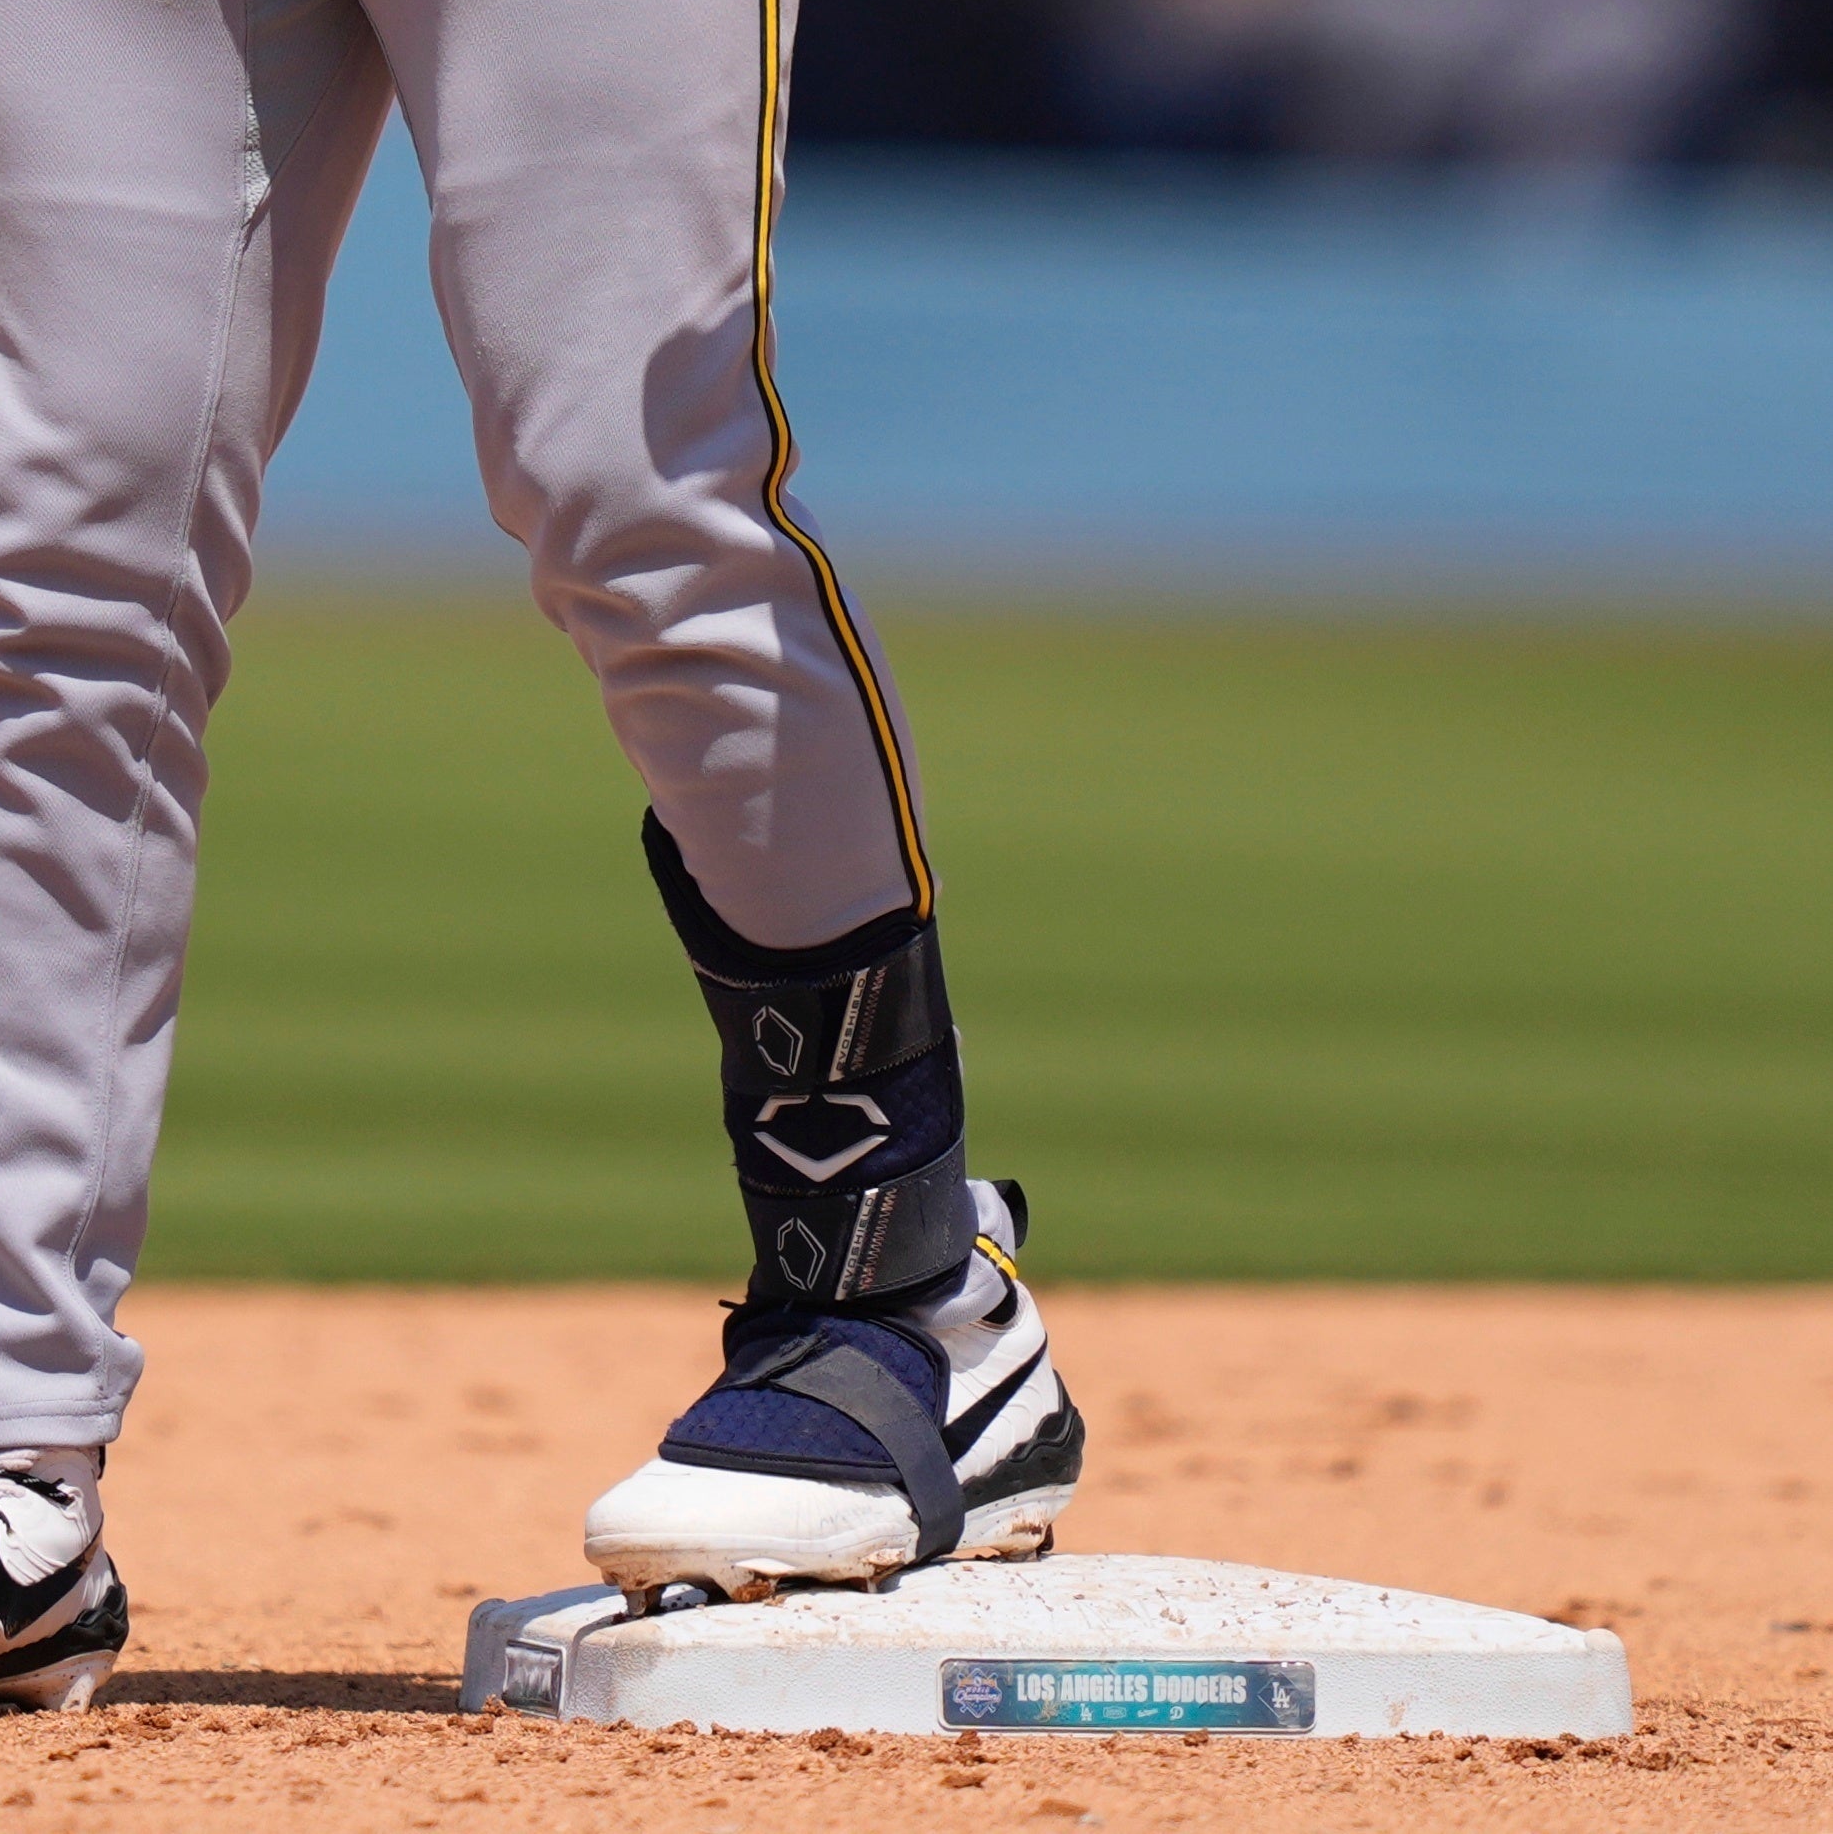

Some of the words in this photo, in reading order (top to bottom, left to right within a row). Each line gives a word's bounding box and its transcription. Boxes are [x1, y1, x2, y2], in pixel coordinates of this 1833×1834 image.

[835, 977, 867, 1072] EVOSHIELD
[841, 1196, 876, 1291] EVOSHIELD
[1016, 1673, 1056, 1702] LOS
[1060, 1674, 1149, 1703] ANGELES
[1152, 1674, 1248, 1704] DODGERS
[1271, 1681, 1291, 1709] LA
